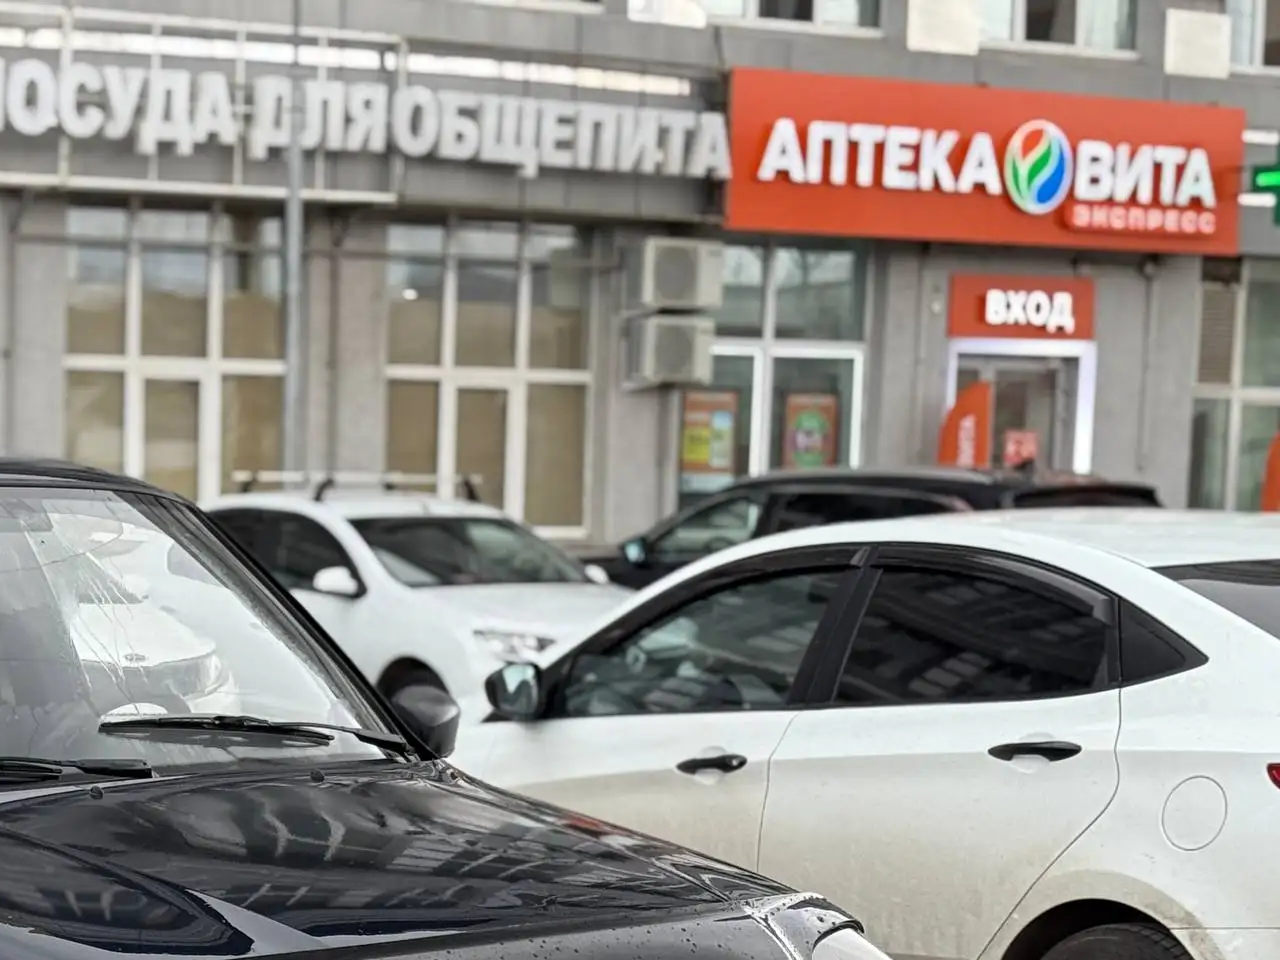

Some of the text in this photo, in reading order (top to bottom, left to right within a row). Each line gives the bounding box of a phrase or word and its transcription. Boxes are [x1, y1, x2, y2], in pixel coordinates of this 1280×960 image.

[247, 74, 389, 161] ДЛЯ
[390, 85, 733, 179] ОБЩЕПИТА
[756, 117, 1217, 208] АПТЕКА ВИТА
[1071, 204, 1217, 234] ЭКСПРЕСС
[984, 288, 1076, 334] ВХОД
